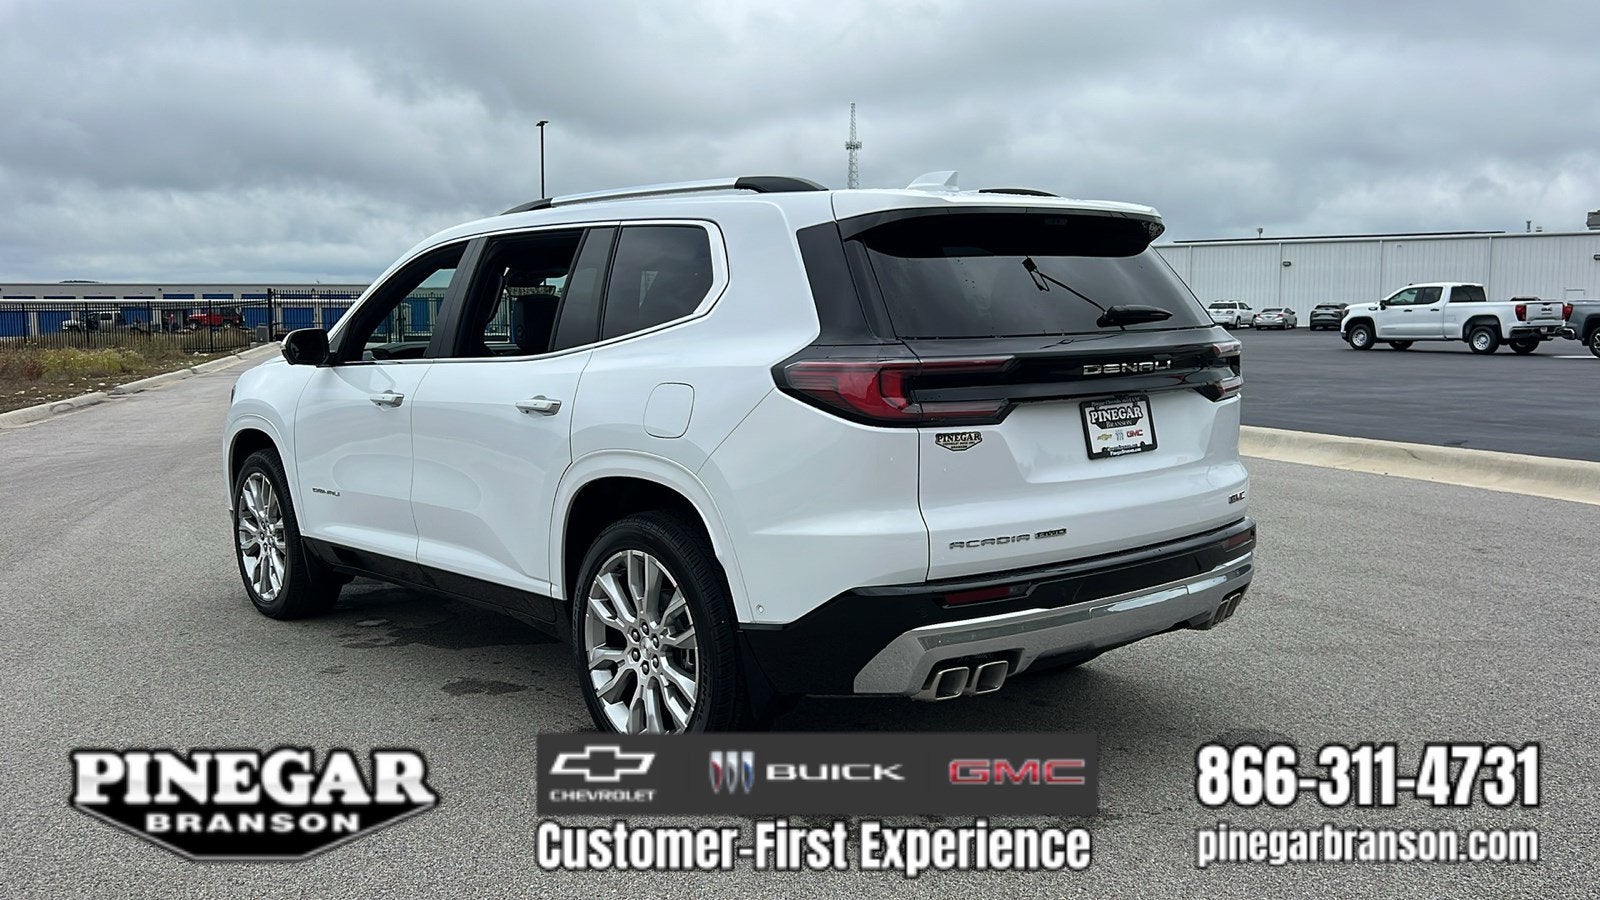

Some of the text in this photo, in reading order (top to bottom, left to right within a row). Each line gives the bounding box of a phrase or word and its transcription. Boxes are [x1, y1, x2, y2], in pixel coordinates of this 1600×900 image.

[1083, 360, 1171, 375] DENALI
[1090, 406, 1143, 423] PINEGAR
[937, 433, 981, 443] PINEGAR
[1126, 429, 1143, 438] GMC
[312, 487, 340, 496] DENALI
[1228, 490, 1245, 504] GMC
[949, 528, 1067, 549] ACADIA AWD
